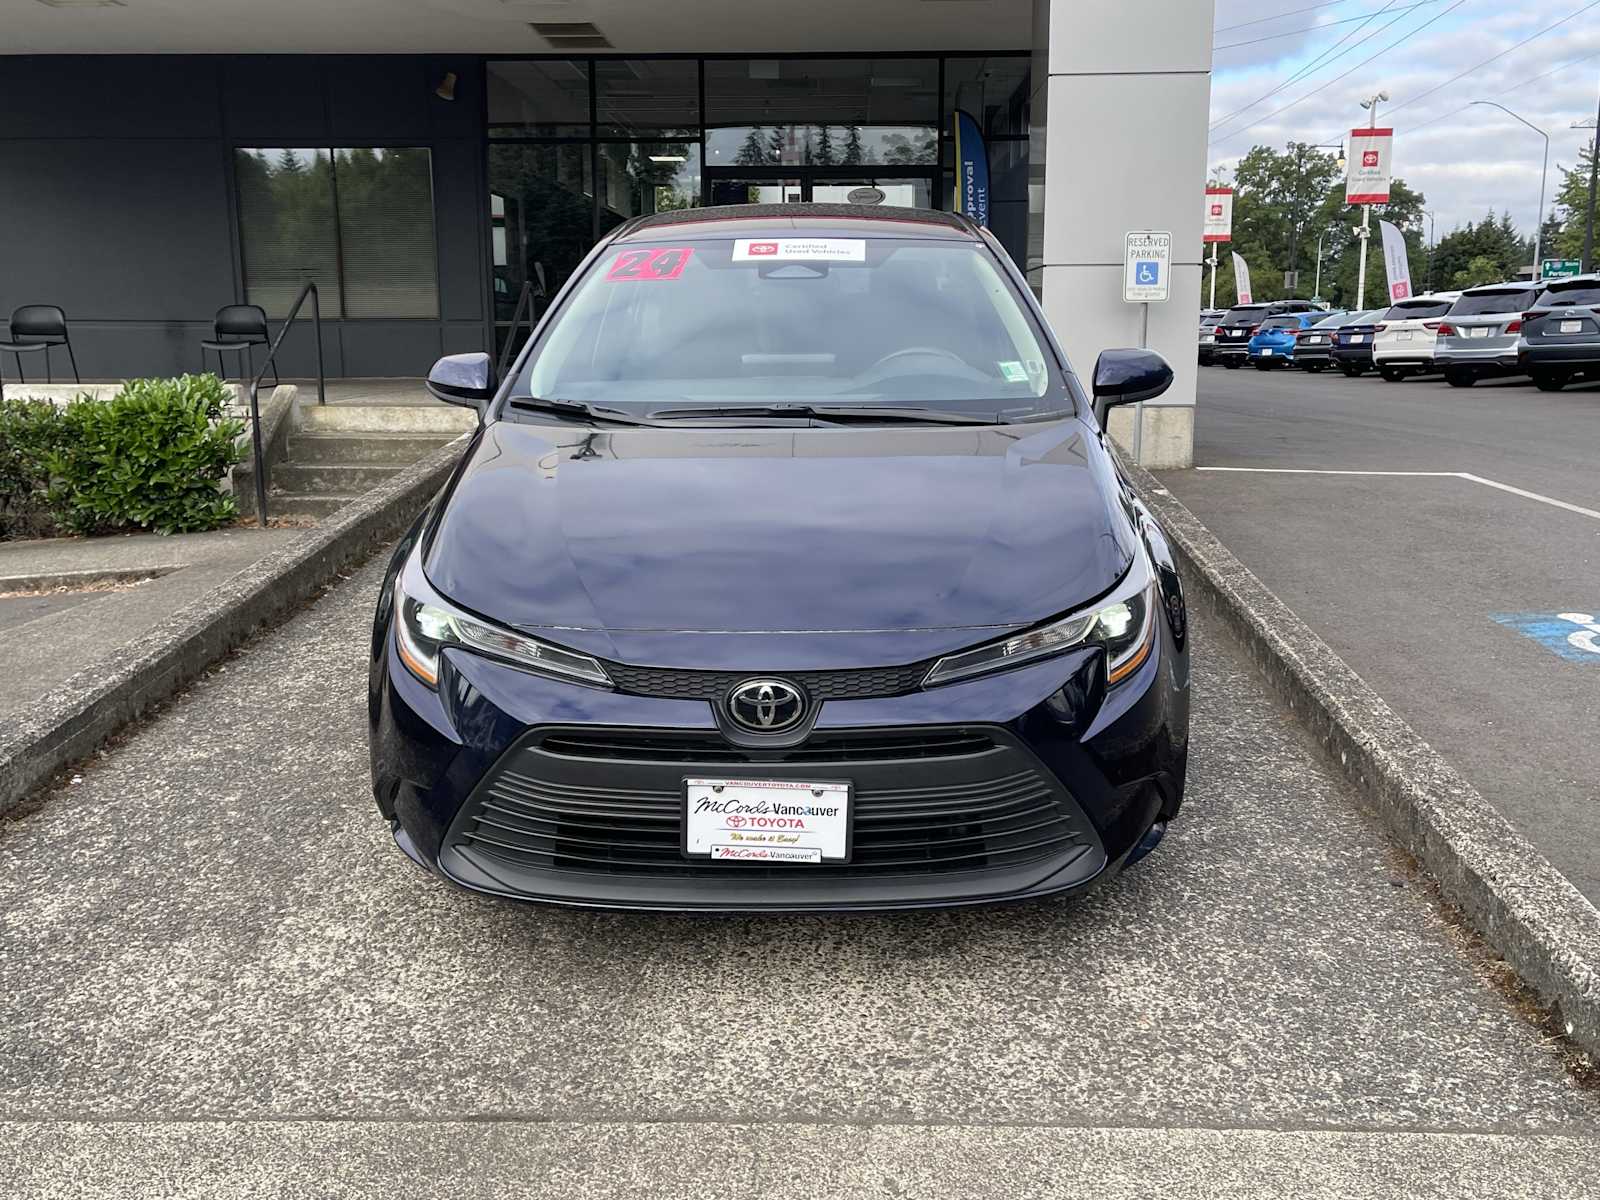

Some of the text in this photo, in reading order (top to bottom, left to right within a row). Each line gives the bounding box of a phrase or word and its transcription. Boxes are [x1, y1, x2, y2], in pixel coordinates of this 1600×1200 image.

[1128, 237, 1169, 247] RESERVED
[1130, 249, 1166, 258] PARKING
[612, 249, 684, 277] 24
[749, 817, 804, 829] TOYOTA
